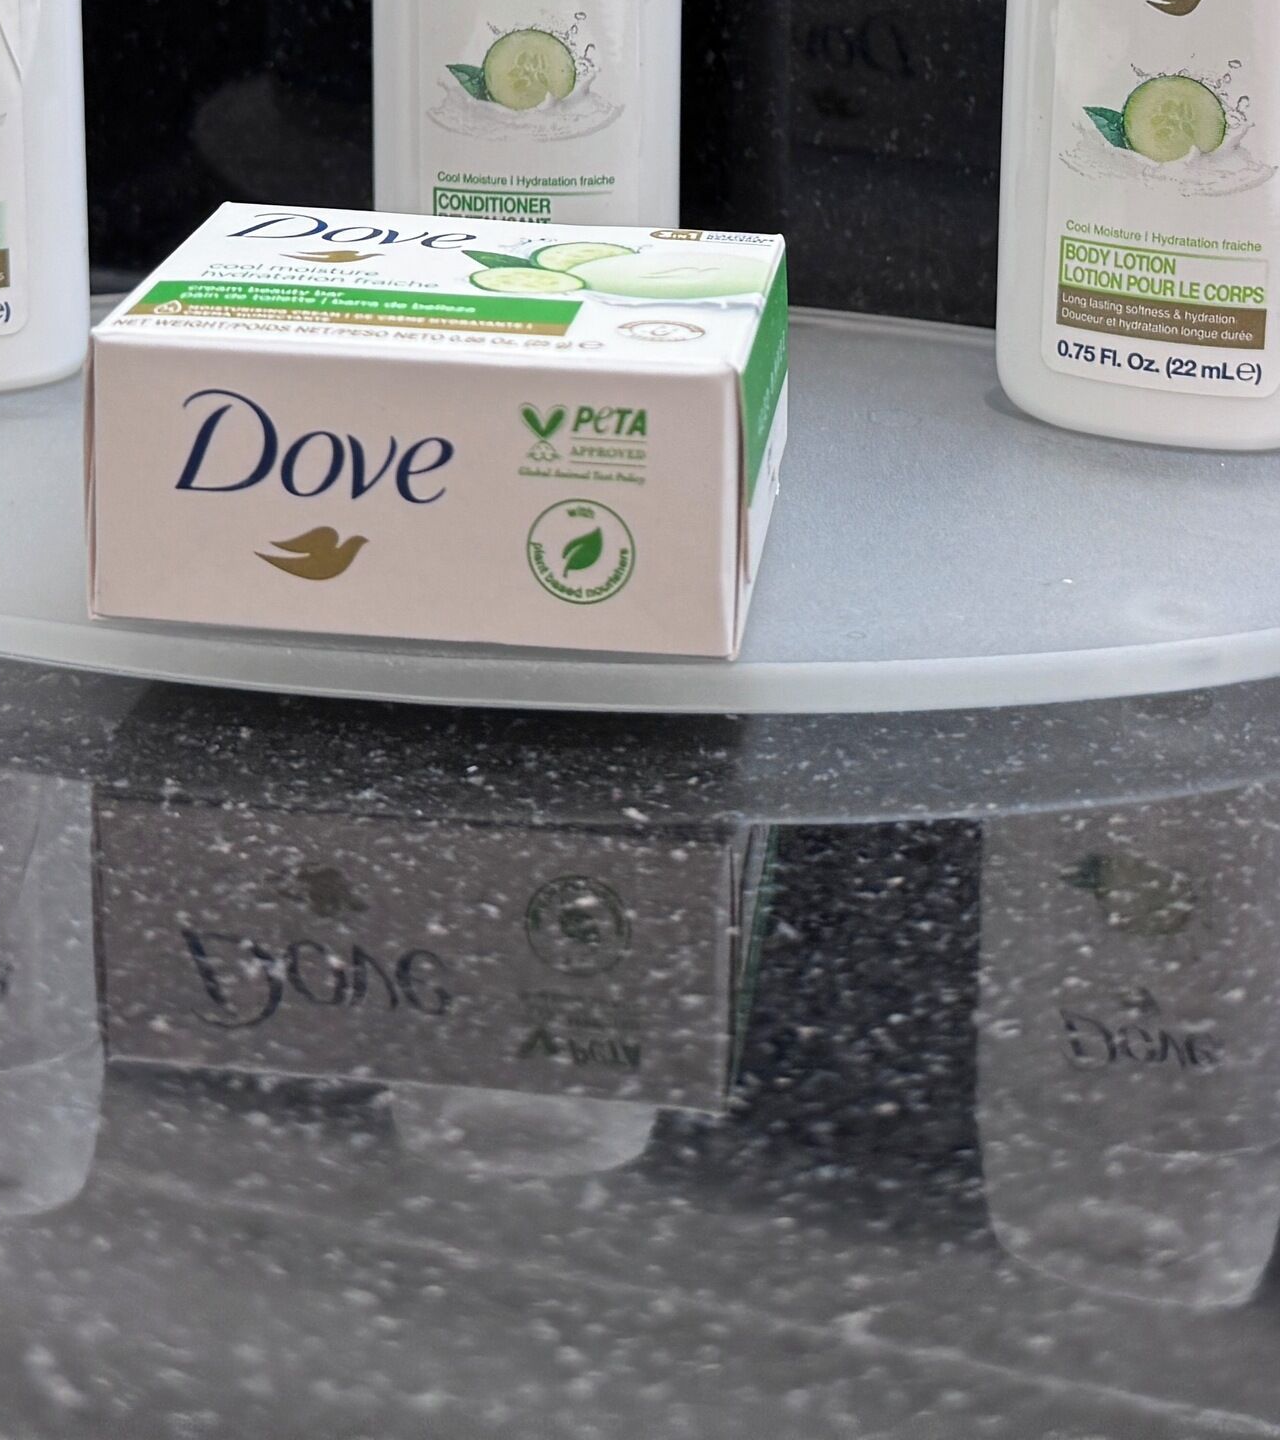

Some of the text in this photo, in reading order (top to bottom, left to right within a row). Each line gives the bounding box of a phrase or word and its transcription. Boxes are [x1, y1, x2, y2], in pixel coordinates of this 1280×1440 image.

[437, 170, 461, 183] Cool
[463, 172, 507, 185] Moisture
[517, 174, 577, 188] Hydratation
[438, 193, 552, 214] CONDITIONER
[226, 212, 477, 250] Dove
[1066, 219, 1091, 234] Cool
[1093, 224, 1142, 241] Moisture
[1152, 232, 1219, 250] Hydratation
[208, 262, 380, 277] cool moisture
[1065, 242, 1176, 276] BODY LOTION
[187, 285, 347, 298] cream beauty bar
[201, 270, 350, 285] hydratation
[1064, 263, 1265, 304] LOTION POUR LE CORPS
[1060, 307, 1254, 342] Douceur et hydratation longue durée
[1062, 292, 1236, 326] Long lasting softness & hydration
[1056, 339, 1096, 363] 0.75
[1100, 348, 1122, 368] Fl.
[1127, 352, 1160, 374] Oz.
[1165, 356, 1197, 378] (22
[175, 388, 455, 505] Dove
[570, 446, 647, 460] APPROVED
[566, 506, 596, 520] with
[528, 542, 550, 576] plant
[544, 571, 583, 599] based
